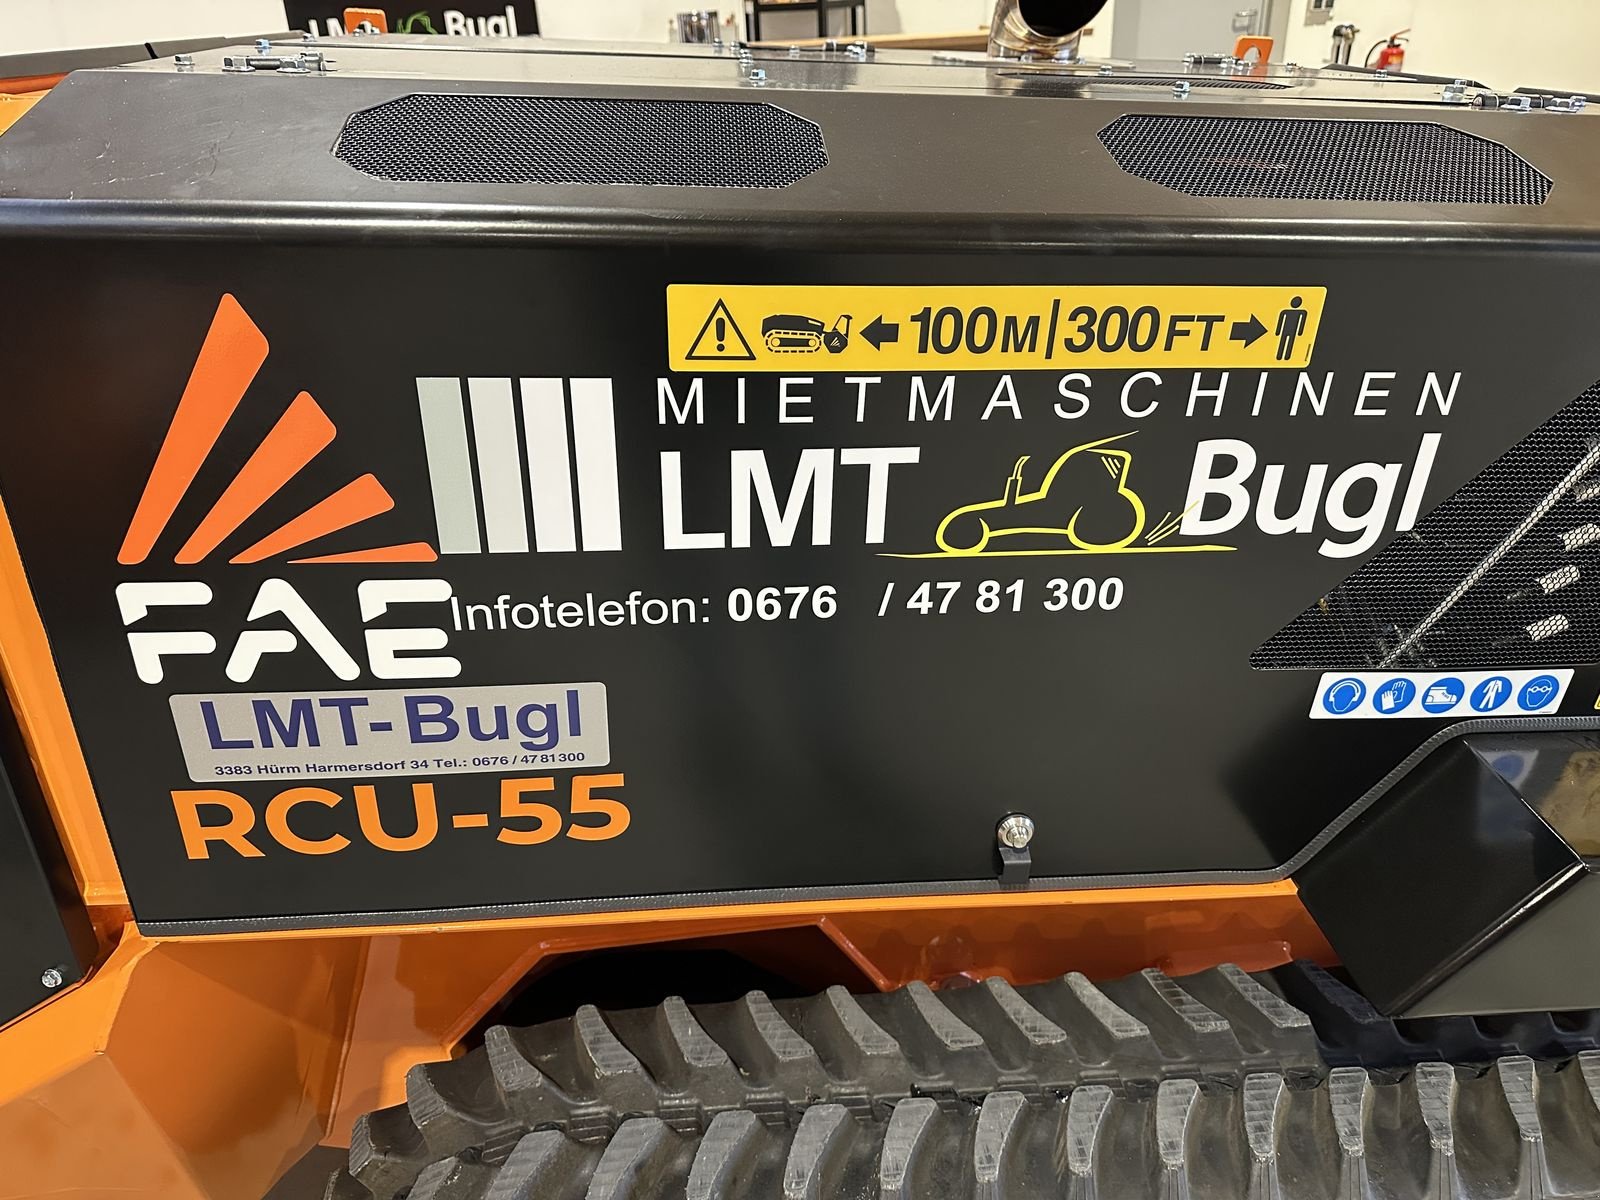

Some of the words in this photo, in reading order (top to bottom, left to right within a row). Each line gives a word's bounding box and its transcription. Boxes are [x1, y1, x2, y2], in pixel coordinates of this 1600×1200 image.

[657, 371, 1462, 425] MIETMASCHINEN
[661, 446, 921, 550] LMT
[1179, 432, 1443, 559] Bugl
[115, 578, 462, 685] FAE
[450, 590, 710, 631] Infotelefon:
[727, 585, 837, 622] 0676
[906, 581, 962, 615] 47
[975, 578, 1025, 613] 81
[1043, 577, 1124, 612] 300
[199, 689, 582, 752] LMT-Bugl
[214, 765, 253, 776] 3383
[256, 762, 301, 775] Hürm
[305, 760, 406, 774] Harmersdorf
[410, 759, 430, 770] 34
[432, 757, 468, 769] Tel.:
[472, 756, 509, 767] 0676
[170, 773, 631, 860] RCU-55
